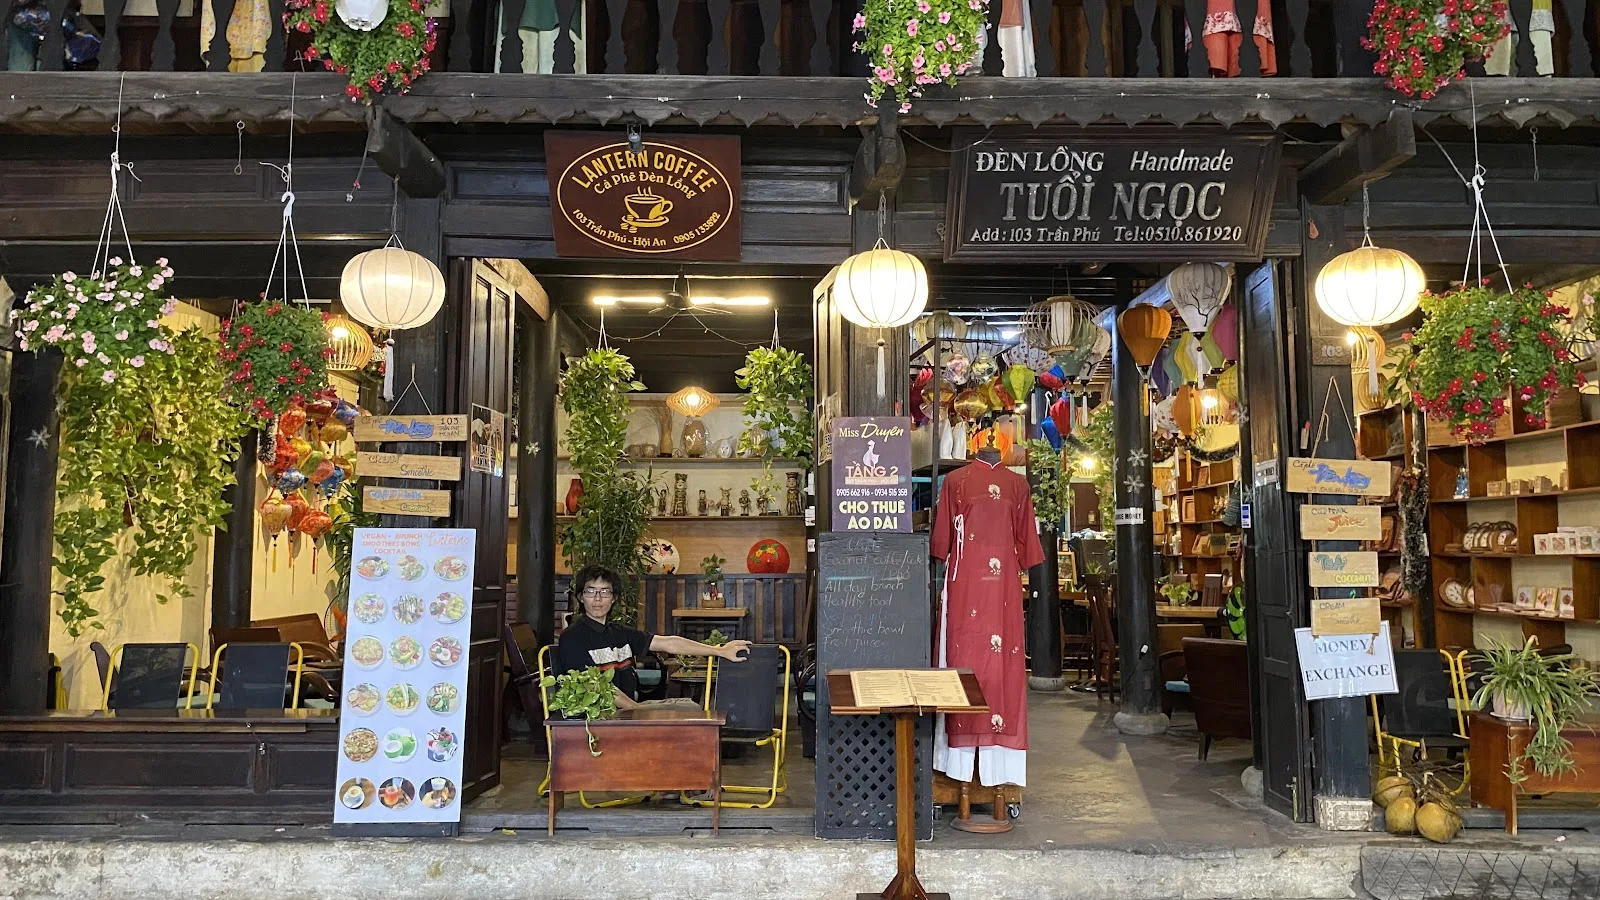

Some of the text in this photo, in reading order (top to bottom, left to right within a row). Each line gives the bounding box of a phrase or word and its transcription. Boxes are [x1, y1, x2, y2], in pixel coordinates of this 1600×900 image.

[976, 145, 1234, 172] ĐÈN LỒNG Handmade
[571, 150, 718, 193] LANTERN COFFEE
[593, 179, 612, 194] Cà
[611, 172, 637, 186] Phê
[639, 170, 664, 184] Đèn
[1108, 181, 1226, 228] NGỌC
[572, 209, 588, 224] 103
[606, 229, 627, 243] Phú
[632, 236, 651, 248] Hội
[652, 237, 667, 247] An
[673, 230, 695, 244] 0905
[1036, 224, 1070, 243] Trần
[1072, 226, 1100, 242] Phú
[440, 417, 459, 425] 103
[839, 422, 904, 442] Miss Duyên
[845, 460, 899, 477] TẦNG 2
[836, 488, 850, 497] 0905
[850, 488, 860, 497] 662
[860, 488, 870, 497] 916
[874, 488, 888, 497] 0934
[888, 488, 898, 497] 515
[898, 488, 908, 497] 358
[838, 500, 906, 514] CHO THUÊ
[1327, 514, 1366, 533] Juice
[825, 580, 840, 592] All
[844, 579, 867, 598] day
[1335, 574, 1373, 584] COCONUT
[1319, 602, 1345, 610] CREAM
[1314, 638, 1369, 654] MONEY
[1305, 663, 1390, 682] EXCHANGE
